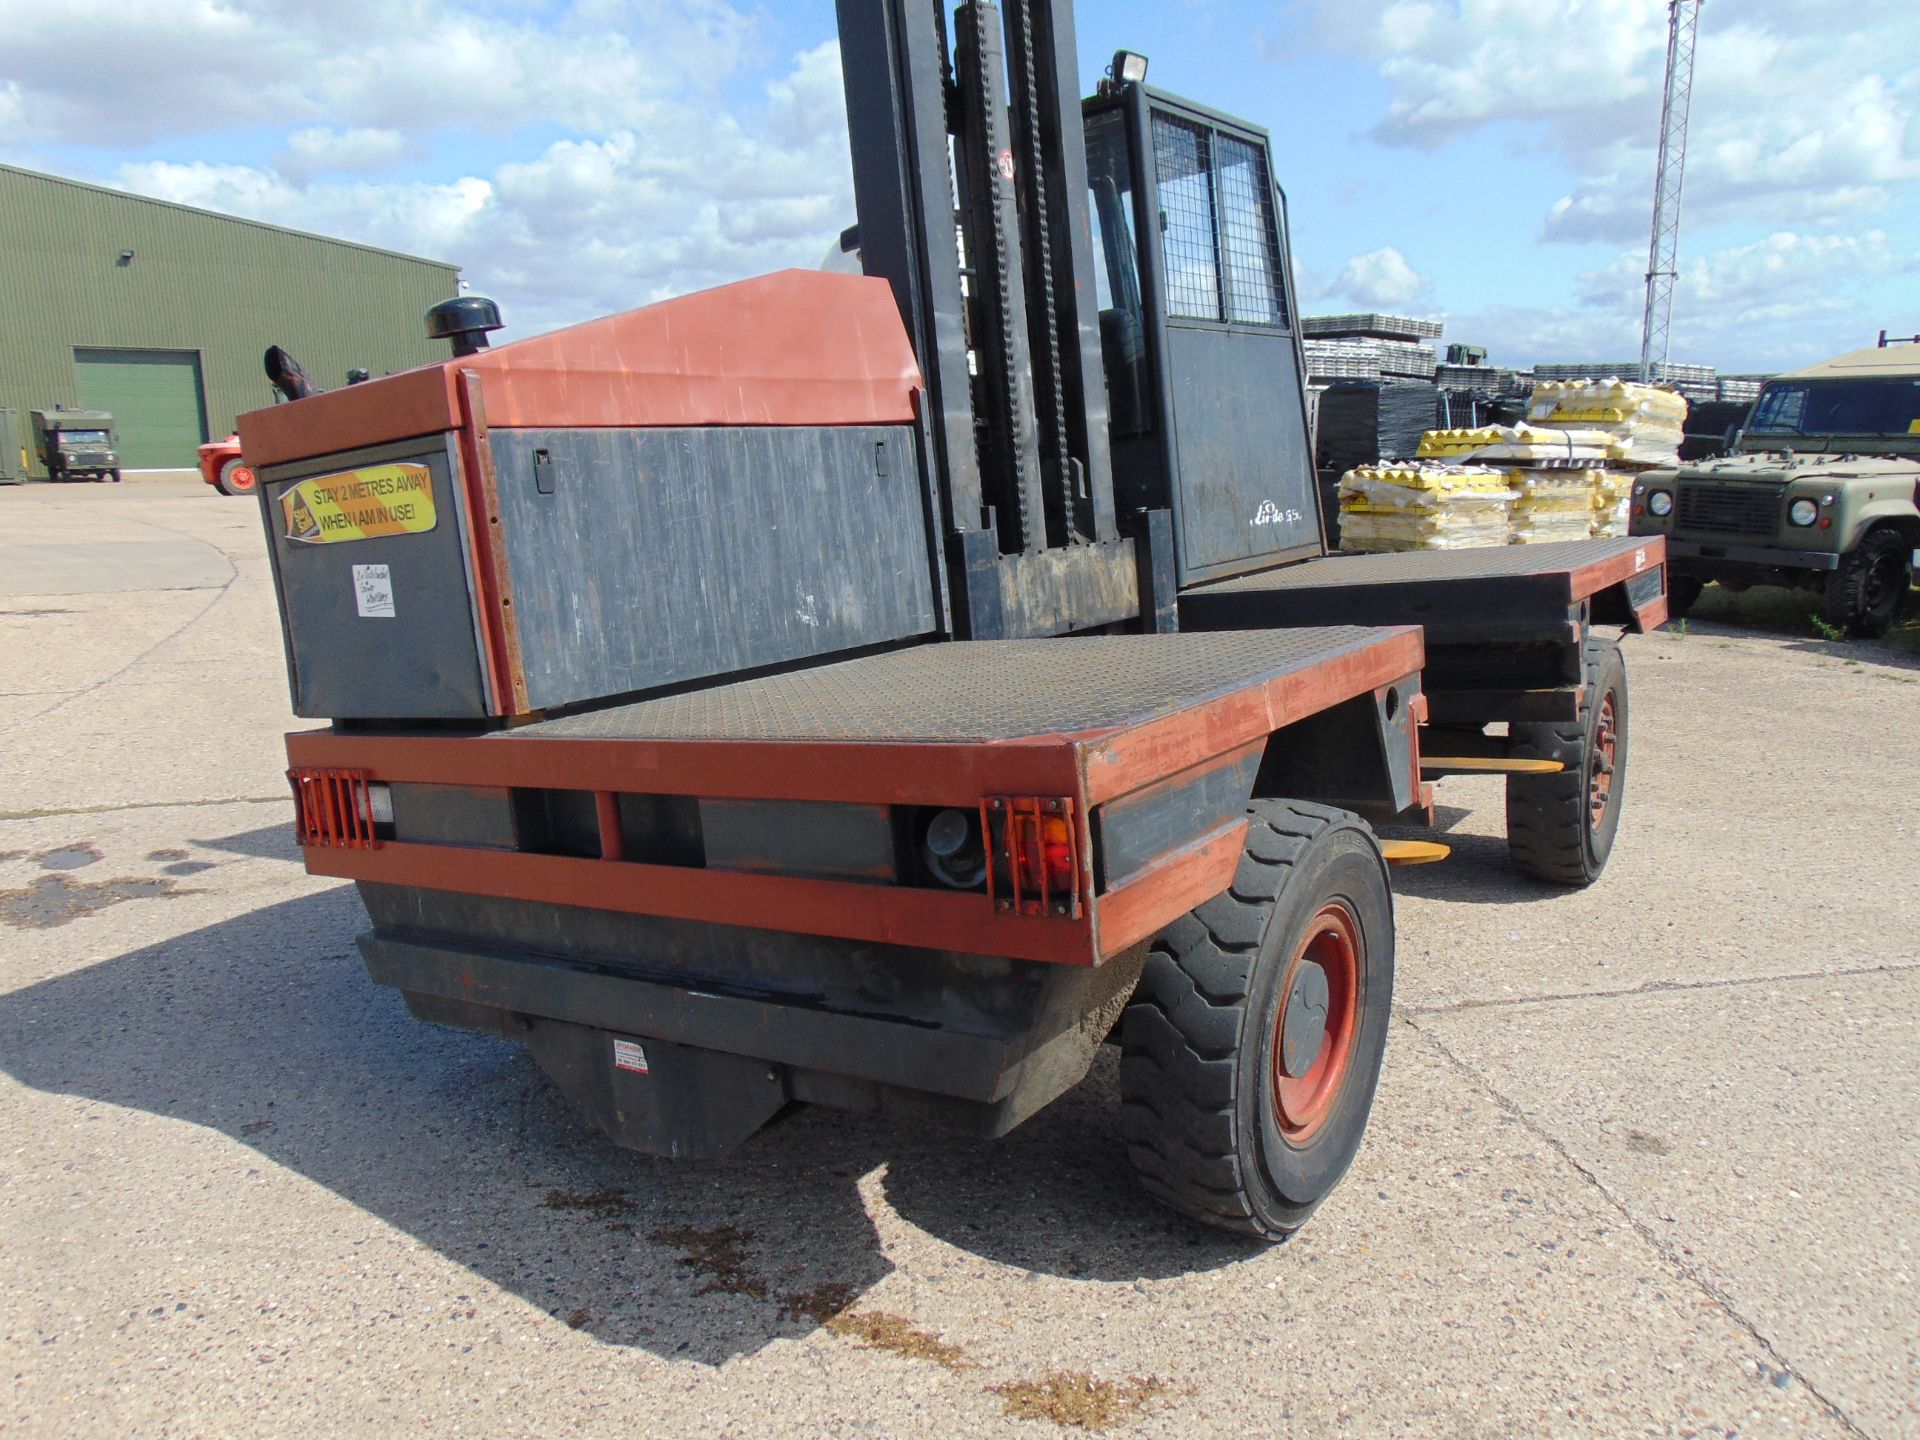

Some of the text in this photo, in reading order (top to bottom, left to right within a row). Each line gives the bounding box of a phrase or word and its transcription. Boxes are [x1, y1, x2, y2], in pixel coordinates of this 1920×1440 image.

[314, 472, 428, 505] STAY 2 METRES AWAY
[320, 512, 352, 531] WHEN
[358, 509, 375, 526] AM
[375, 506, 388, 524] IN
[388, 503, 416, 523] USE!
